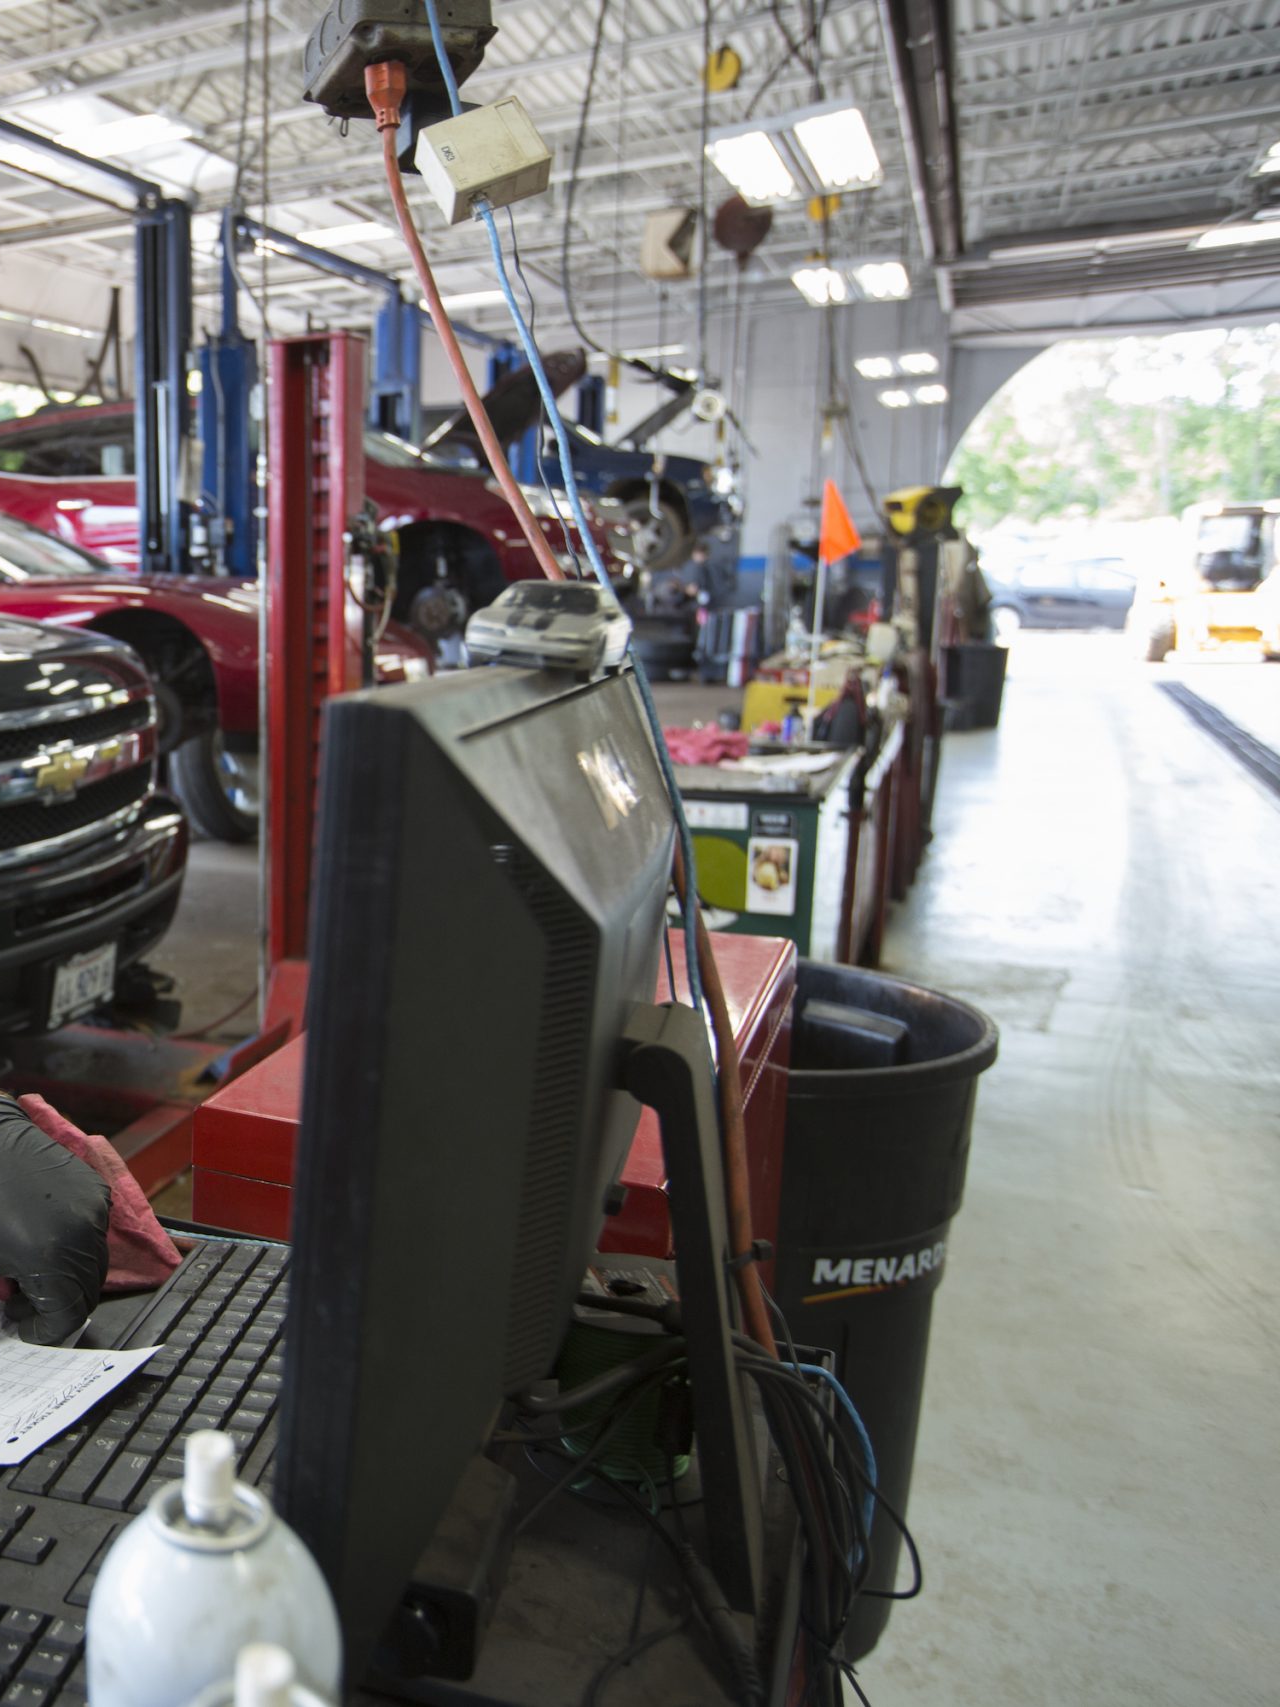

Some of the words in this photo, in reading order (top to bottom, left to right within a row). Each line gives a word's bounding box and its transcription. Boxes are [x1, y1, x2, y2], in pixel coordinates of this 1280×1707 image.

[812, 1240, 946, 1286] MENARD
[76, 1374, 101, 1393] DAILY
[52, 1394, 75, 1410] TIME
[20, 1411, 54, 1435] TICKET
